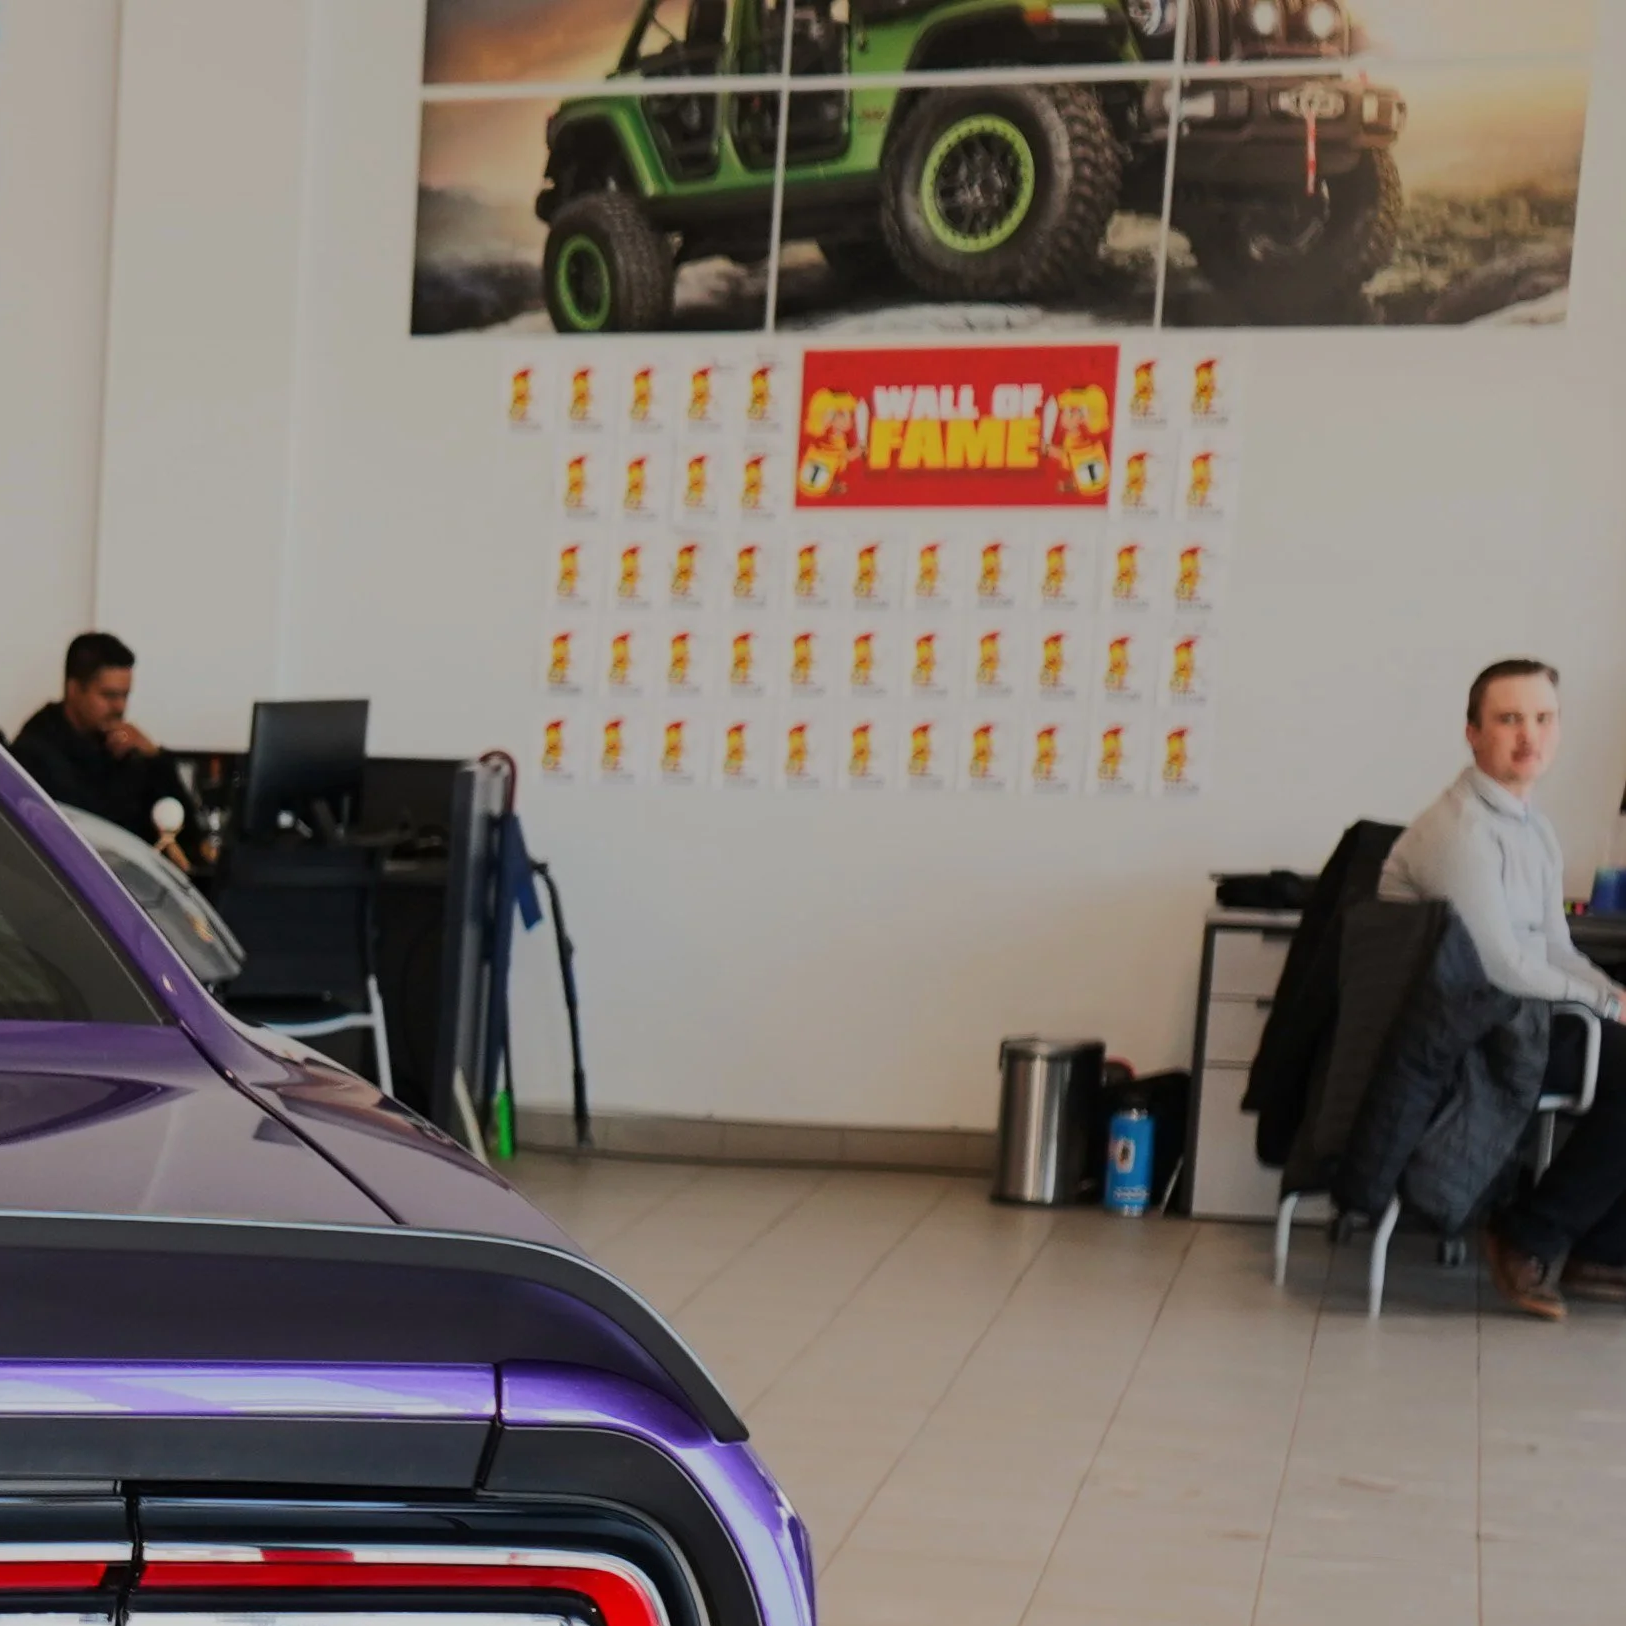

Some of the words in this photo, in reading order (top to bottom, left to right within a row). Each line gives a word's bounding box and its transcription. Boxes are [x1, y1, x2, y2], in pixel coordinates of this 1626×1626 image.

[873, 384, 979, 419] WALL
[992, 383, 1042, 417] OF
[868, 416, 1041, 469] FAME
